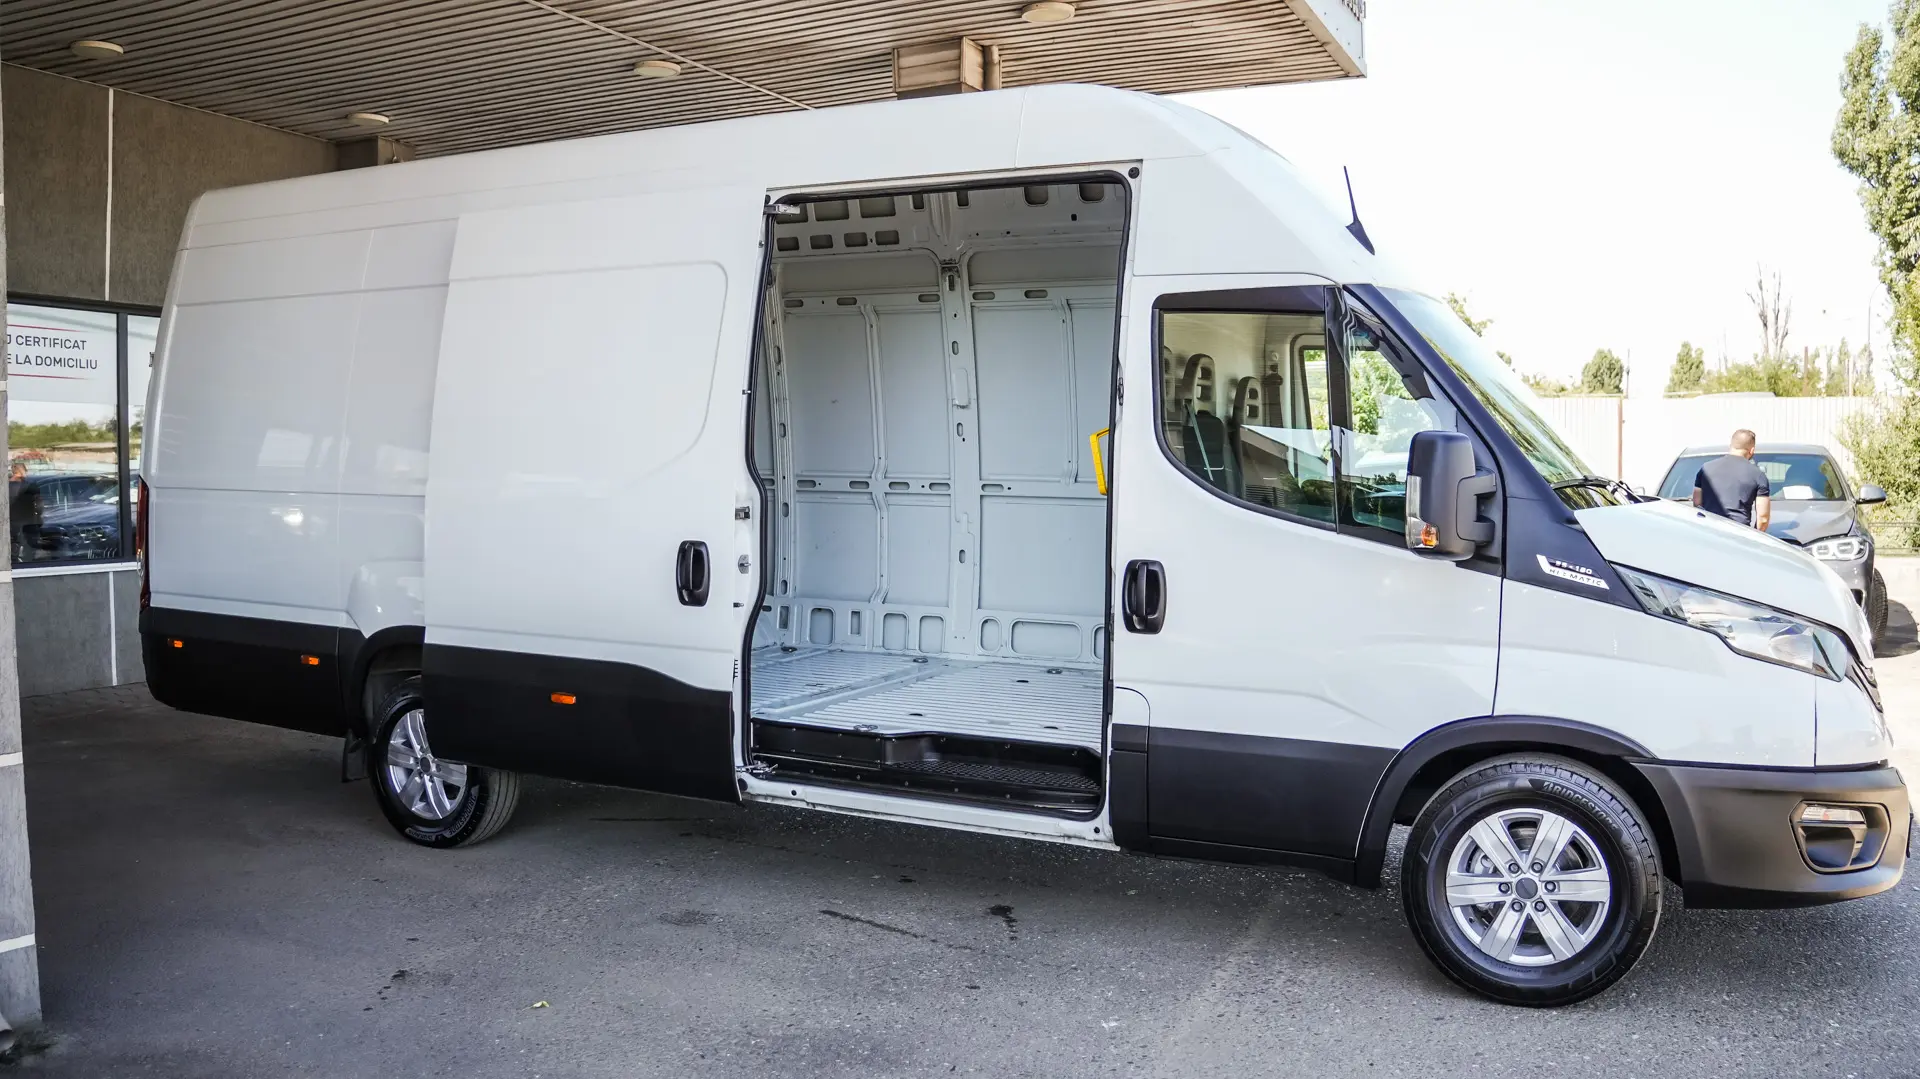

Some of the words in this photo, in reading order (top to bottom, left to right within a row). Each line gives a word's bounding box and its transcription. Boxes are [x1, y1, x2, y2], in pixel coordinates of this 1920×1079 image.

[15, 334, 87, 350] CERTIFICAT
[15, 353, 32, 366] LA
[35, 355, 98, 370] DOMICILIU
